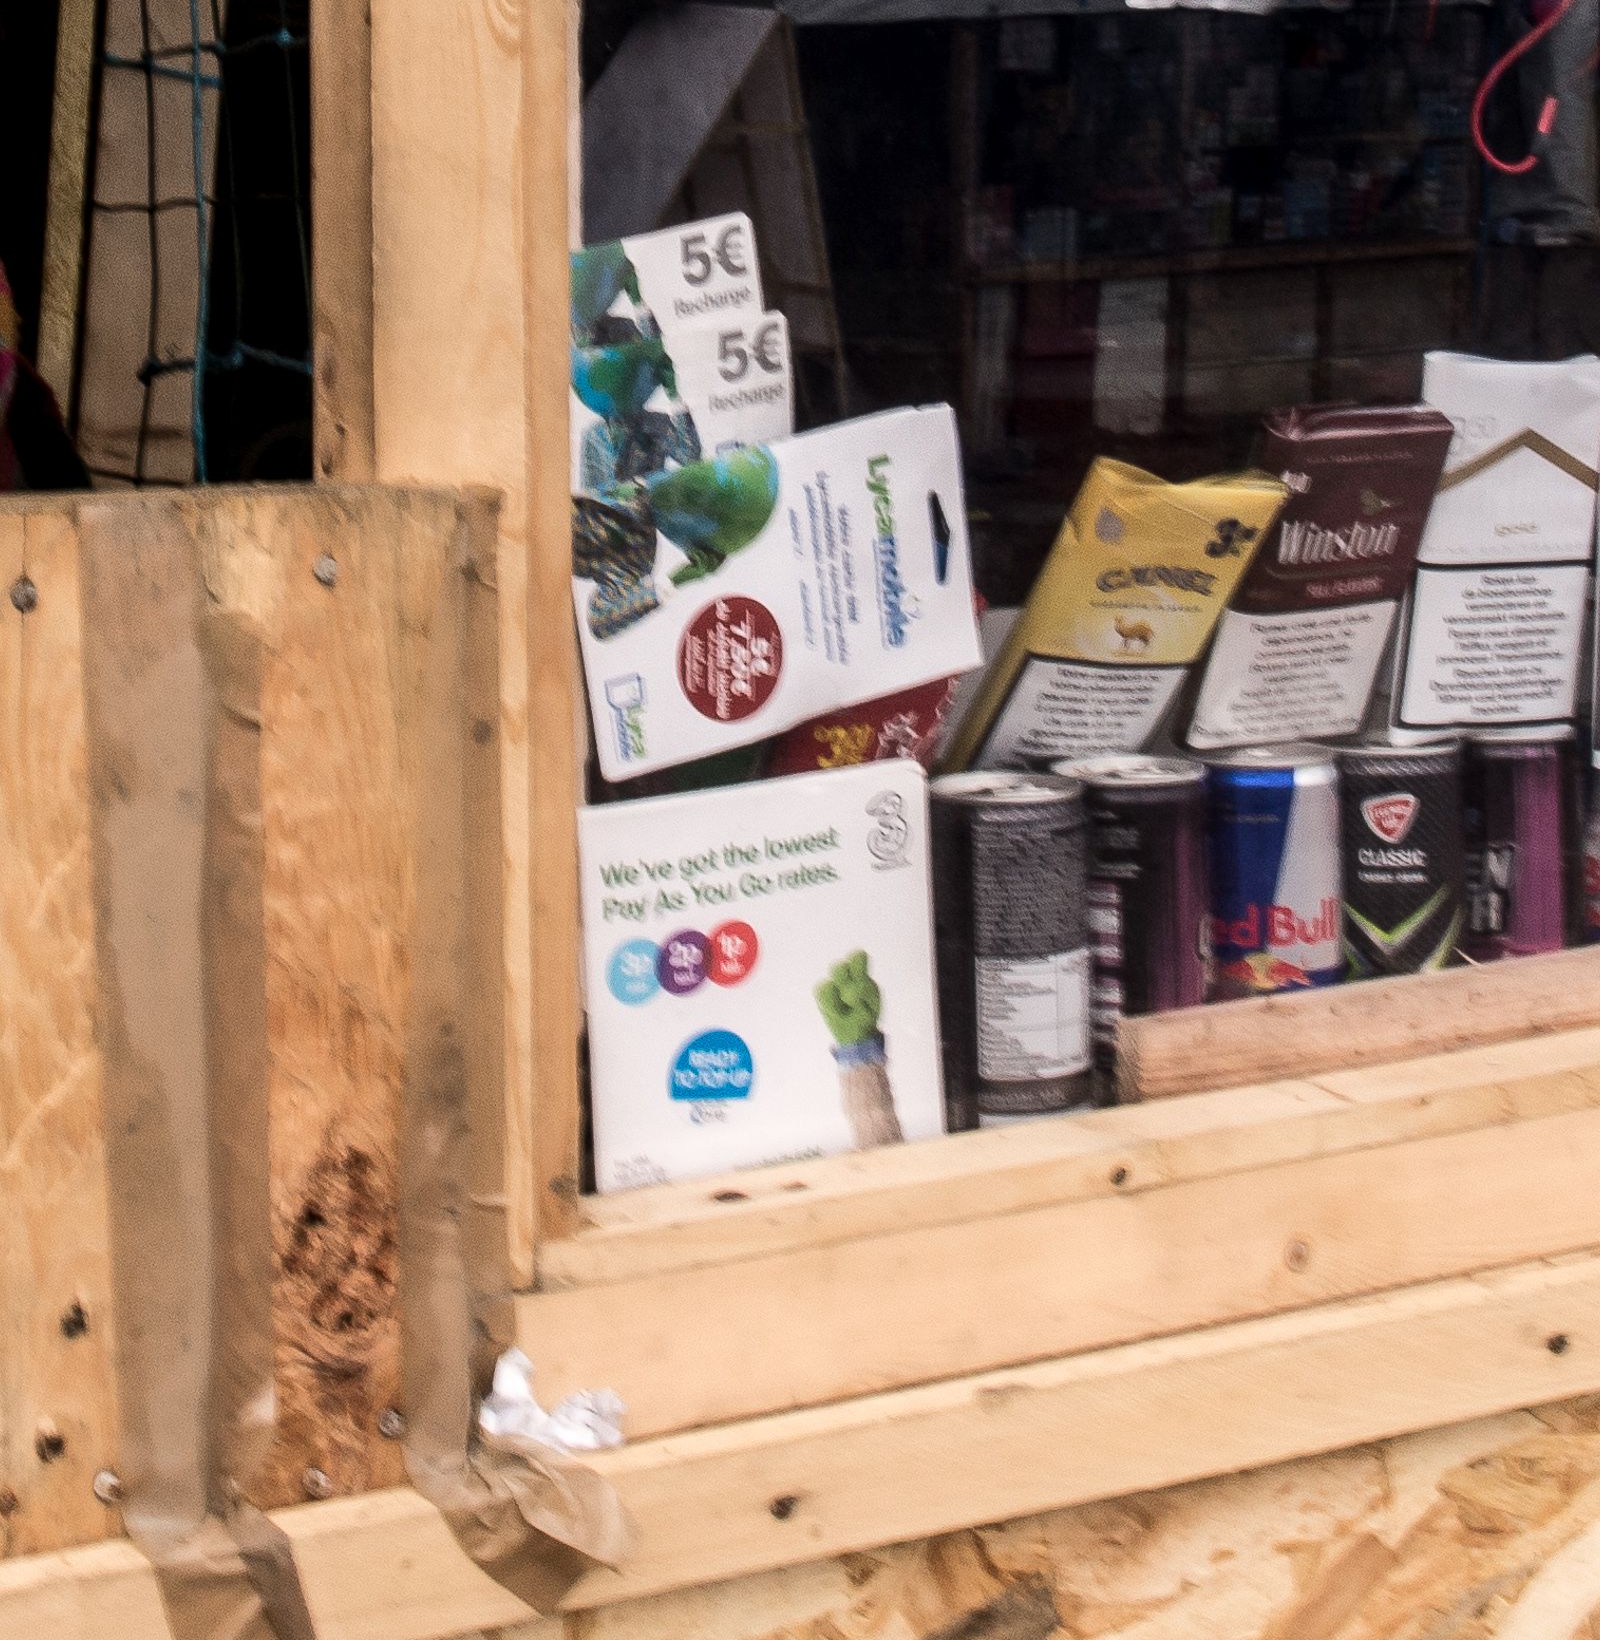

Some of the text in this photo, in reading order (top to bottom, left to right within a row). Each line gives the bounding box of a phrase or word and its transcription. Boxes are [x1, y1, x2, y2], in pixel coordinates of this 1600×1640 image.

[679, 223, 748, 288] 5€
[673, 285, 753, 320] Recharge
[717, 319, 784, 384] 5€
[1278, 521, 1398, 565] Winston
[600, 825, 841, 889] We've got the lowest
[1358, 847, 1428, 868] CLASSIC
[690, 881, 736, 906] You
[738, 871, 775, 898] Go
[777, 862, 841, 890] rates
[1212, 894, 1340, 948] ed Bull
